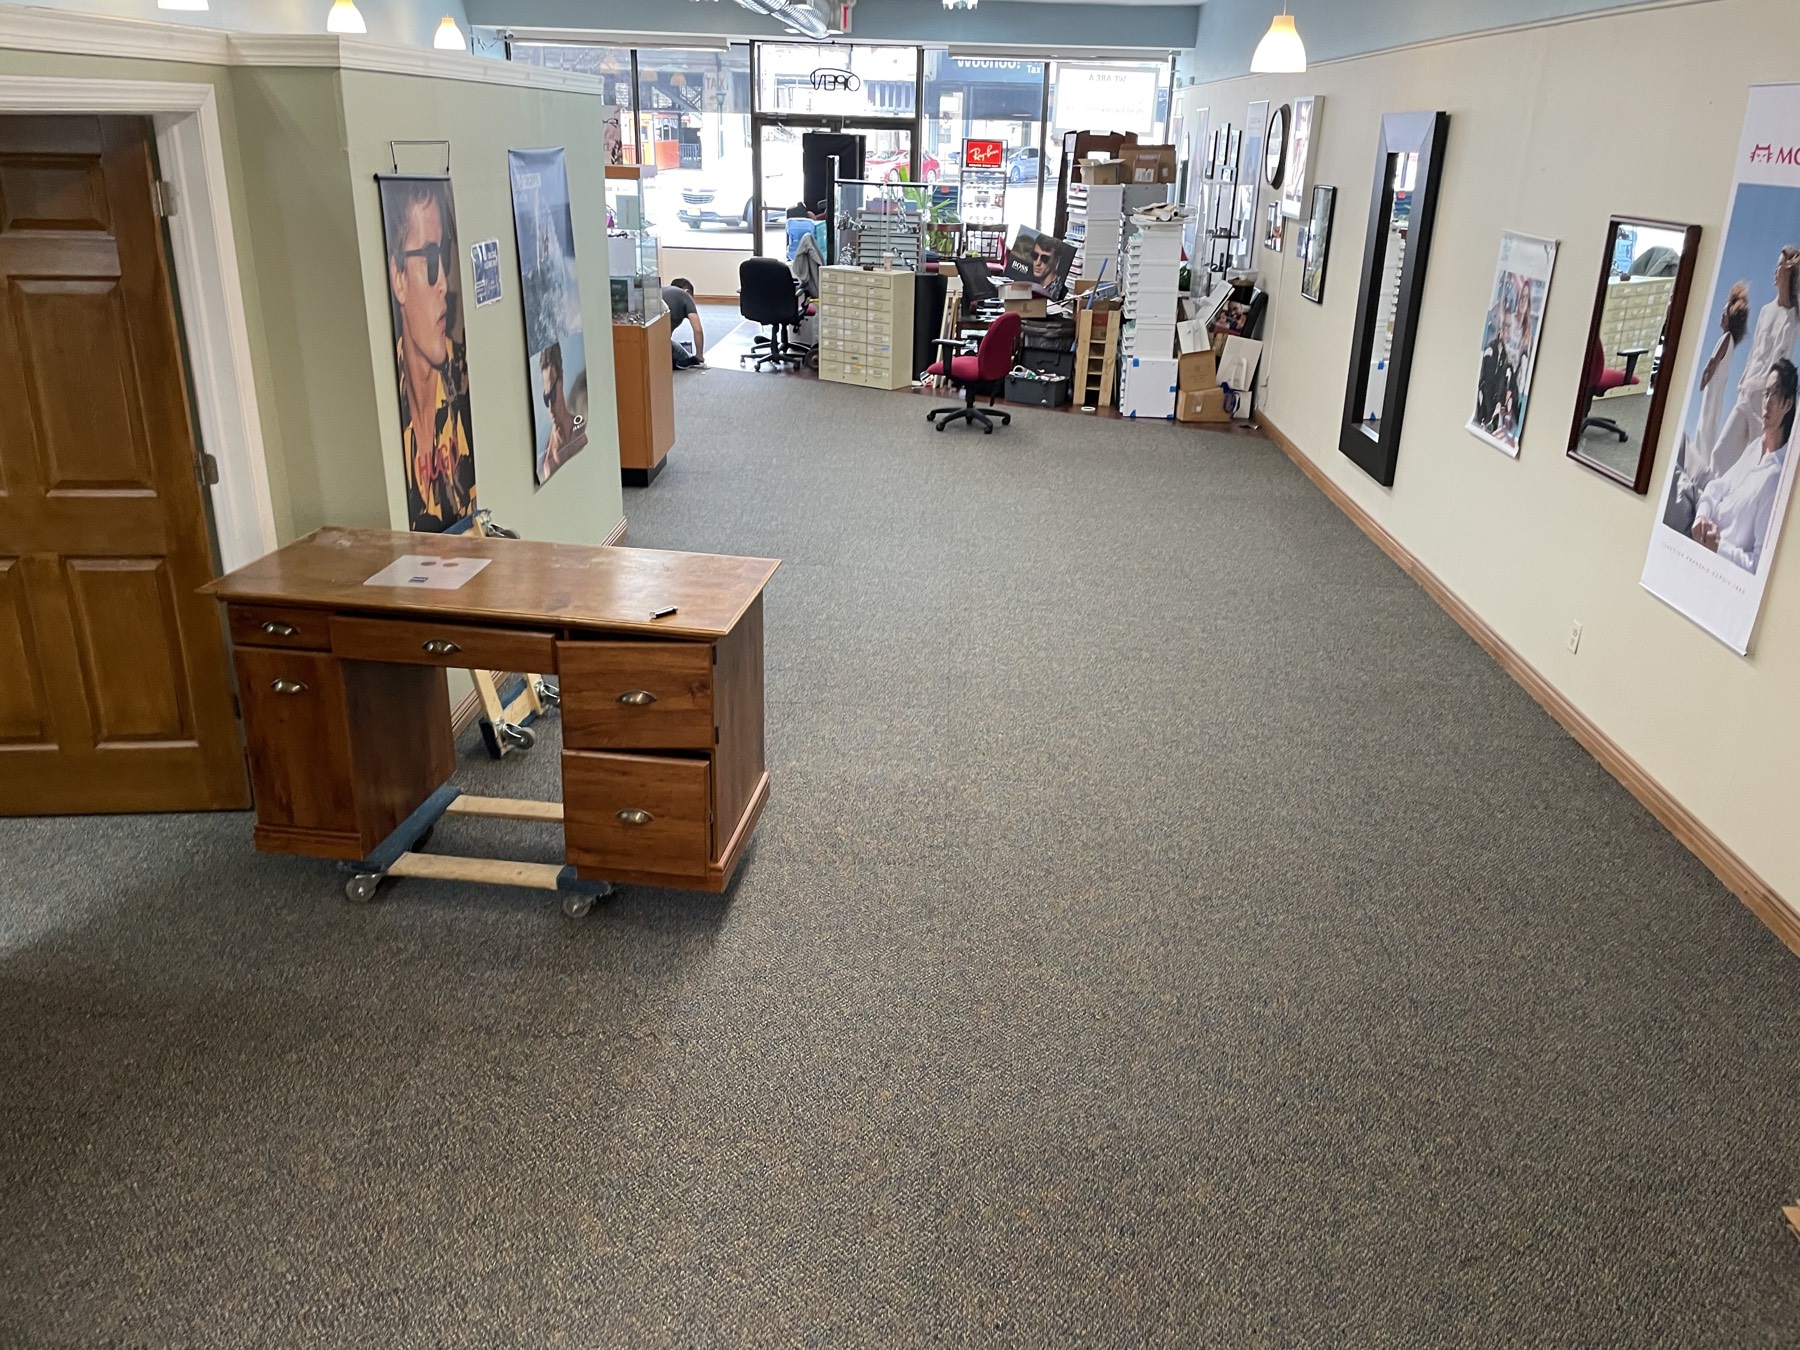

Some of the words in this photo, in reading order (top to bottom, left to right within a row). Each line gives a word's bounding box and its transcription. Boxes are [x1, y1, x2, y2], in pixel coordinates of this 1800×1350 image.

[1026, 65, 1041, 74] Tax
[969, 144, 1000, 162] Ray-Ban
[1012, 260, 1029, 273] BOSS
[417, 437, 460, 487] HUGO
